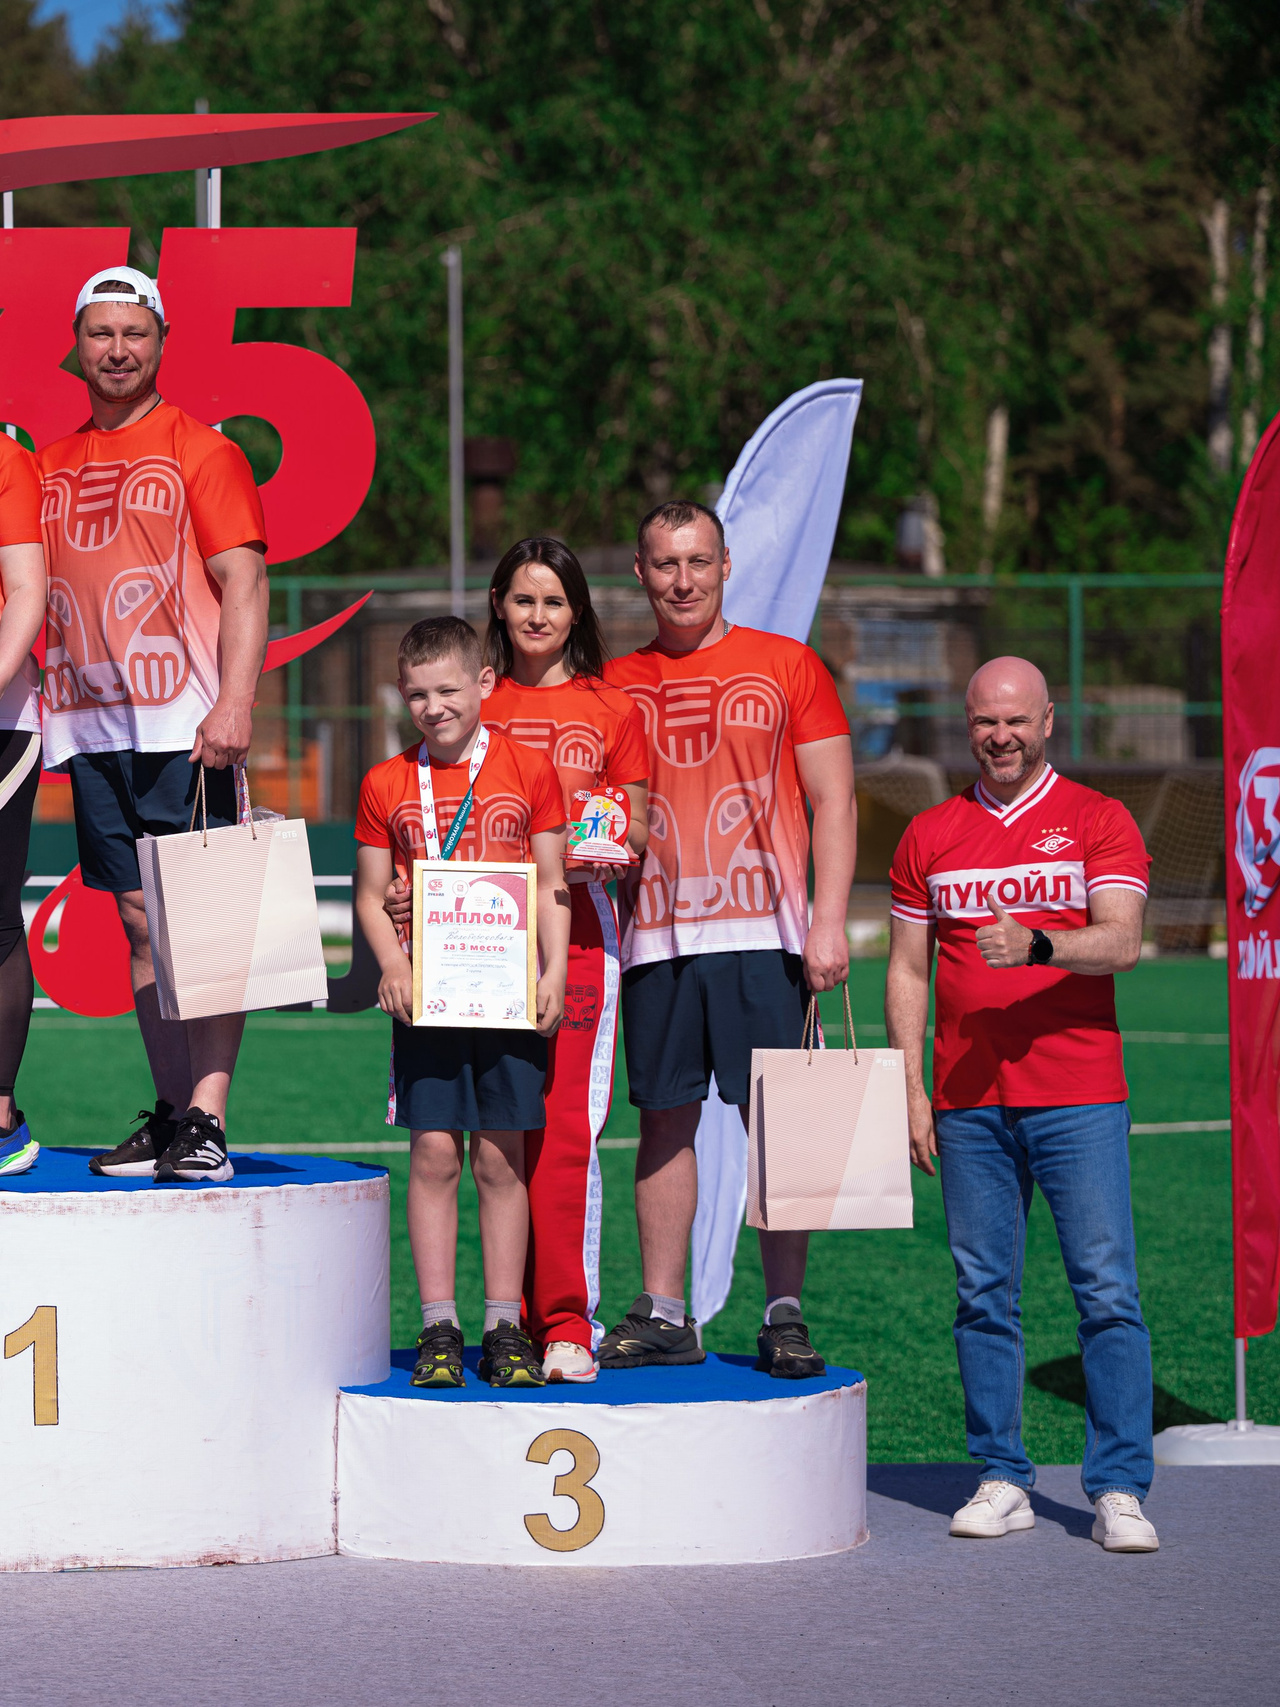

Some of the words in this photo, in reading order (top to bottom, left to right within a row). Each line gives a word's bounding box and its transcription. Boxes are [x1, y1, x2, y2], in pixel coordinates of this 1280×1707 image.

[568, 821, 588, 846] 3
[937, 869, 1072, 913] ЛУКОЙЛ
[427, 911, 512, 925] ДИПЛОМ
[443, 943, 456, 951] за
[459, 942, 466, 951] 3
[470, 944, 505, 952] место
[4, 1305, 59, 1426] 1
[524, 1428, 605, 1552] 3
